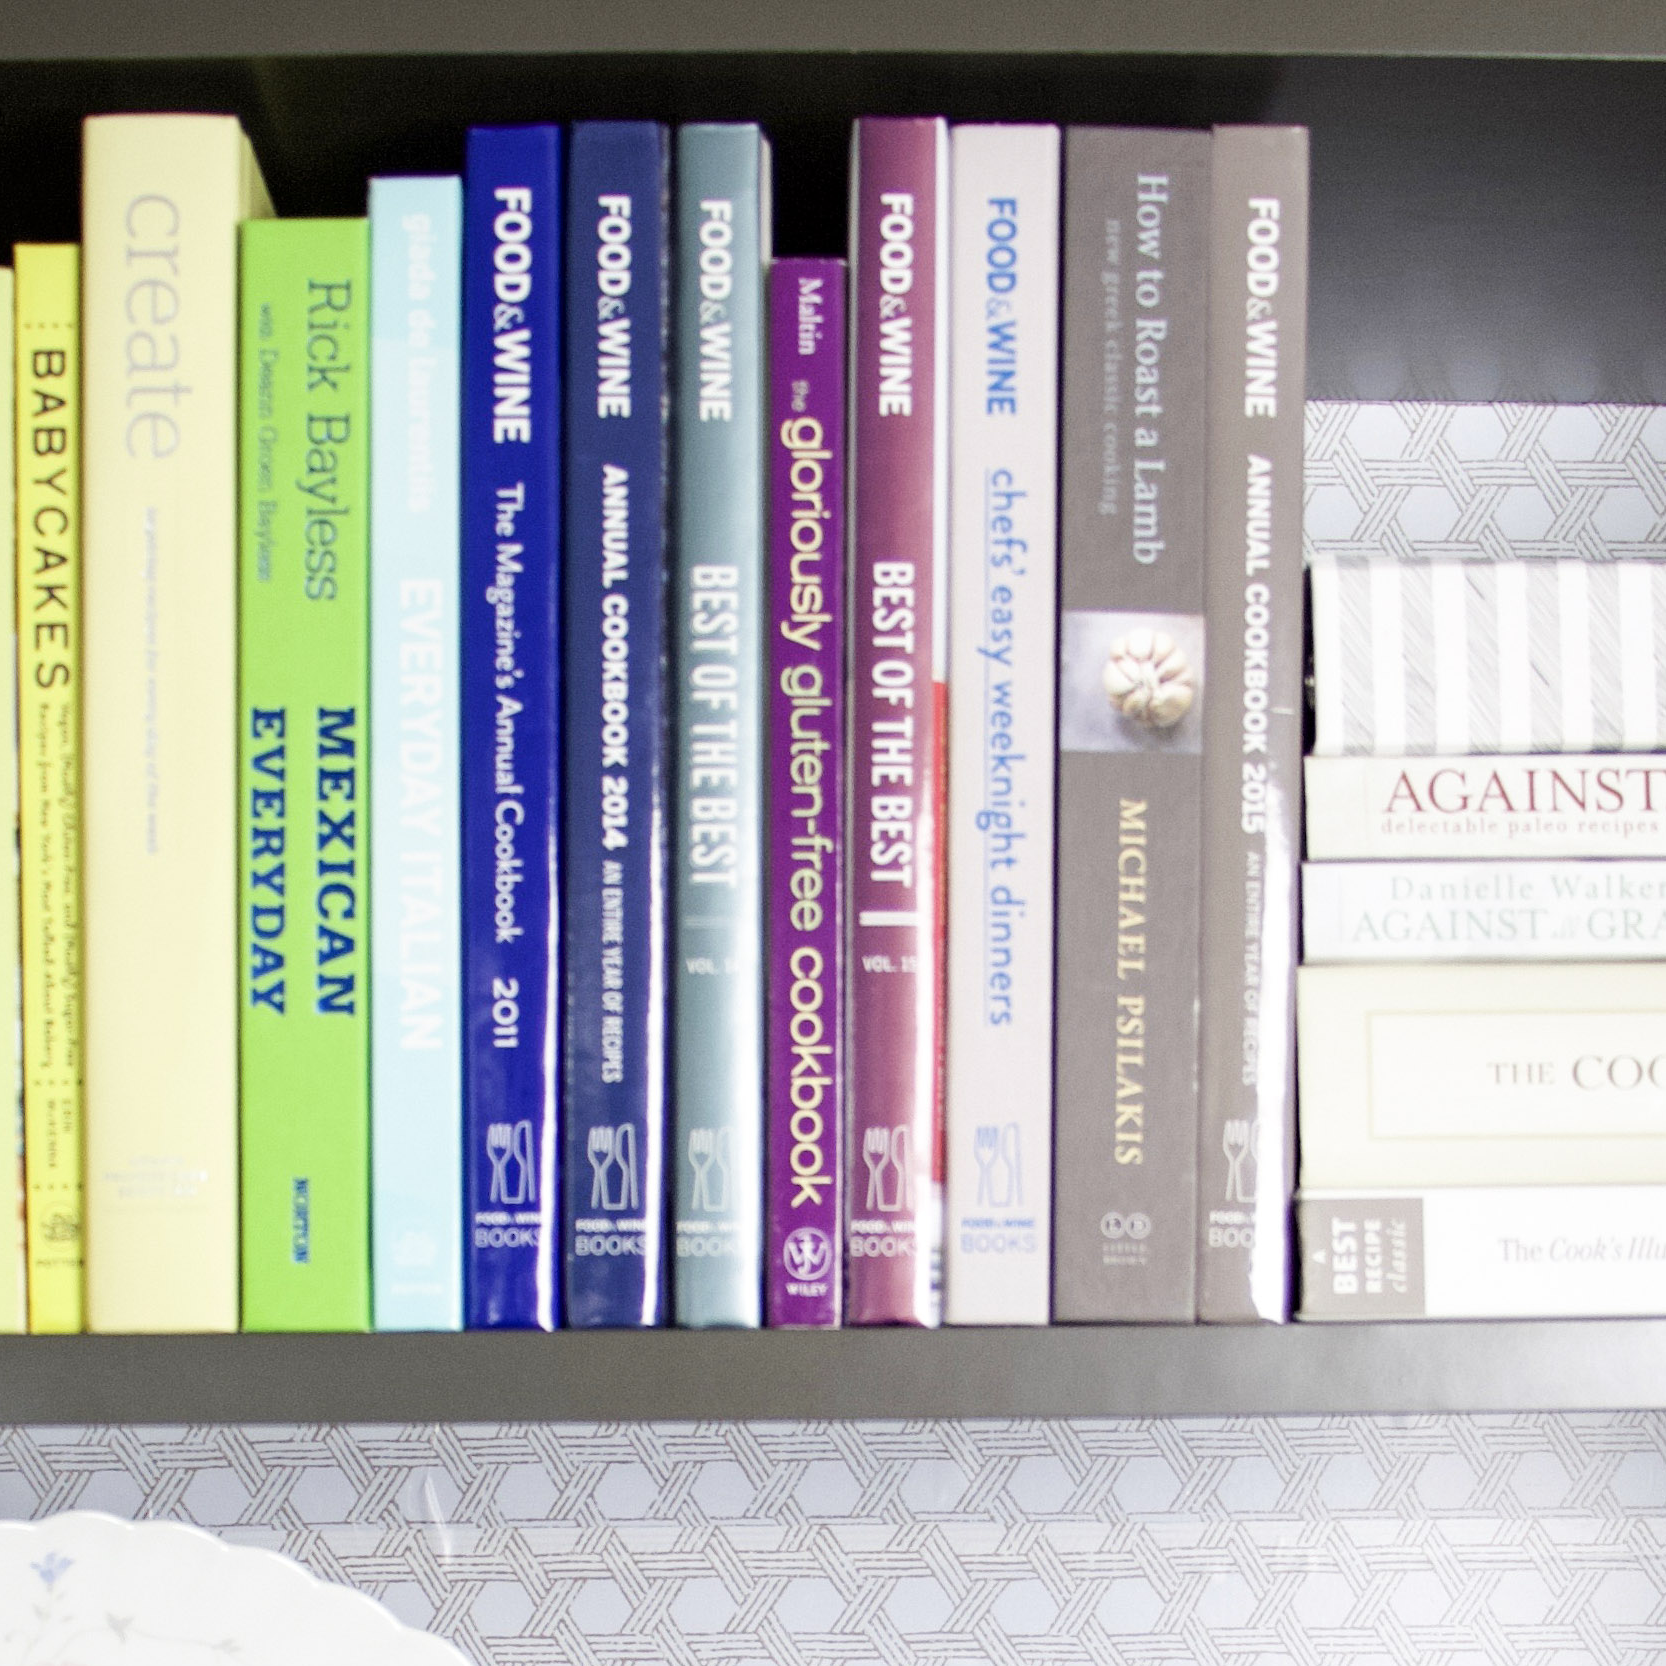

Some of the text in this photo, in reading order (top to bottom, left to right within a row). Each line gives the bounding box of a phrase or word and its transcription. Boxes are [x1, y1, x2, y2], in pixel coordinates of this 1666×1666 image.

[124, 193, 192, 459] create
[295, 278, 352, 602] Rick Bayless
[400, 213, 438, 514] giada de laurentiis
[1098, 217, 1124, 516] new greek classic cooking
[1132, 174, 1171, 566] How to Roast a Lamb
[31, 347, 70, 691] BABYCAKES
[255, 500, 279, 583] Bayless
[485, 186, 533, 1048] FOOD&WINE The Magazine's Annual Cookbook 2011
[596, 194, 632, 1084] FOOD&WINE ANNUAL COOKBOOK 2014 AN ENTIRE YEAR OF RECIPES
[690, 199, 739, 888] FOOD&WINE BEST OF THE BEST
[870, 192, 915, 888] FOOD&WINE BEST OF THE BEST
[975, 197, 1029, 1027] FOOD&WINE chefs' easy weeknight dinners
[1239, 197, 1281, 836] FOOD&WINE ANNUAL COOKBOOK 2015
[250, 708, 286, 1016] EVERYDAY
[314, 706, 356, 1016] MEXICAN
[398, 577, 444, 1052] EVERYDAY ITALIAN
[780, 416, 834, 1208] gloriously gluten-free cookbook
[1351, 908, 1550, 942] AGAINST
[1381, 815, 1500, 835] delectable
[1507, 816, 1569, 840] paleo
[1576, 816, 1660, 841] recipes
[1390, 874, 1535, 901] Danielle
[1113, 798, 1148, 1166] MICHAEL PSILAKIS
[1487, 1060, 1555, 1086] THE
[784, 1281, 828, 1297] WILEY
[1332, 1217, 1359, 1294] BEST
[1364, 1218, 1383, 1294] RECIPE
[1385, 1217, 1409, 1294] classic
[1497, 1238, 1543, 1263] The
[1548, 1236, 1624, 1263] Cook's
